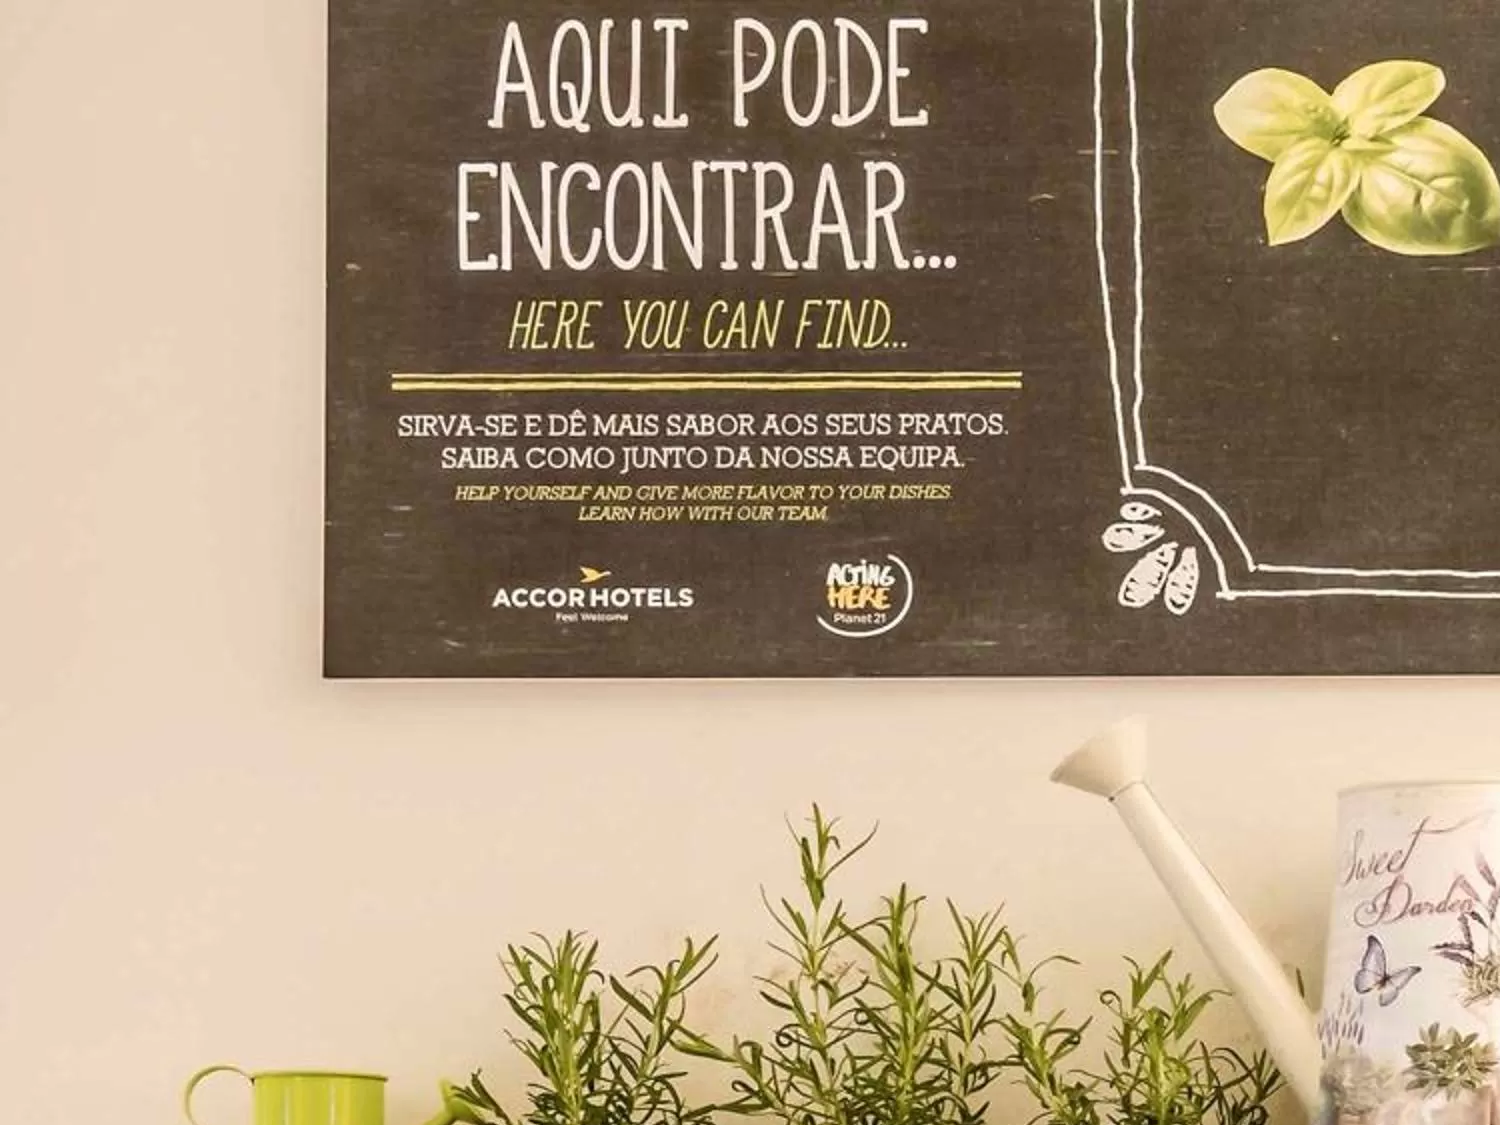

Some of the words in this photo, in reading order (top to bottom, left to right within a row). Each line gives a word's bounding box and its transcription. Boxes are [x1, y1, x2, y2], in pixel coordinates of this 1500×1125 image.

[487, 17, 691, 133] AQUI
[733, 17, 929, 128] PODE
[458, 161, 957, 272] ENCONTRAR...
[508, 300, 603, 350] HERE
[623, 300, 691, 350] YOU
[704, 300, 784, 349] CAN
[398, 414, 518, 437] SIRVA-SE
[524, 415, 542, 437] E
[548, 409, 587, 437] DÊ
[593, 414, 659, 437] MAIS
[666, 412, 759, 438] SABOR
[762, 414, 819, 436] AOS
[825, 414, 892, 436] SEUS
[898, 414, 1009, 436] PRATOS.
[441, 447, 520, 470] SAIBA
[526, 447, 614, 470] COMO
[619, 446, 708, 474] JUNTO
[714, 446, 755, 468] DA
[761, 445, 856, 469] NOSSA
[859, 445, 965, 472] EQUIPA.
[455, 486, 501, 501] HELP
[503, 486, 594, 501] YOURSELF
[594, 486, 632, 501] AND
[636, 486, 677, 501] GIVE
[682, 484, 734, 501] MORE
[736, 485, 806, 500] FLAVOR
[809, 485, 834, 500] TO
[838, 485, 886, 500] YOUR
[578, 506, 633, 521] LEARN
[638, 506, 684, 521] HOW
[686, 505, 734, 522] WITH
[736, 507, 775, 521] OUR
[827, 586, 891, 610] HERE
[555, 612, 578, 623] Feel
[581, 612, 629, 622] Welcome
[833, 613, 872, 624] Planet
[873, 613, 887, 623] 21
